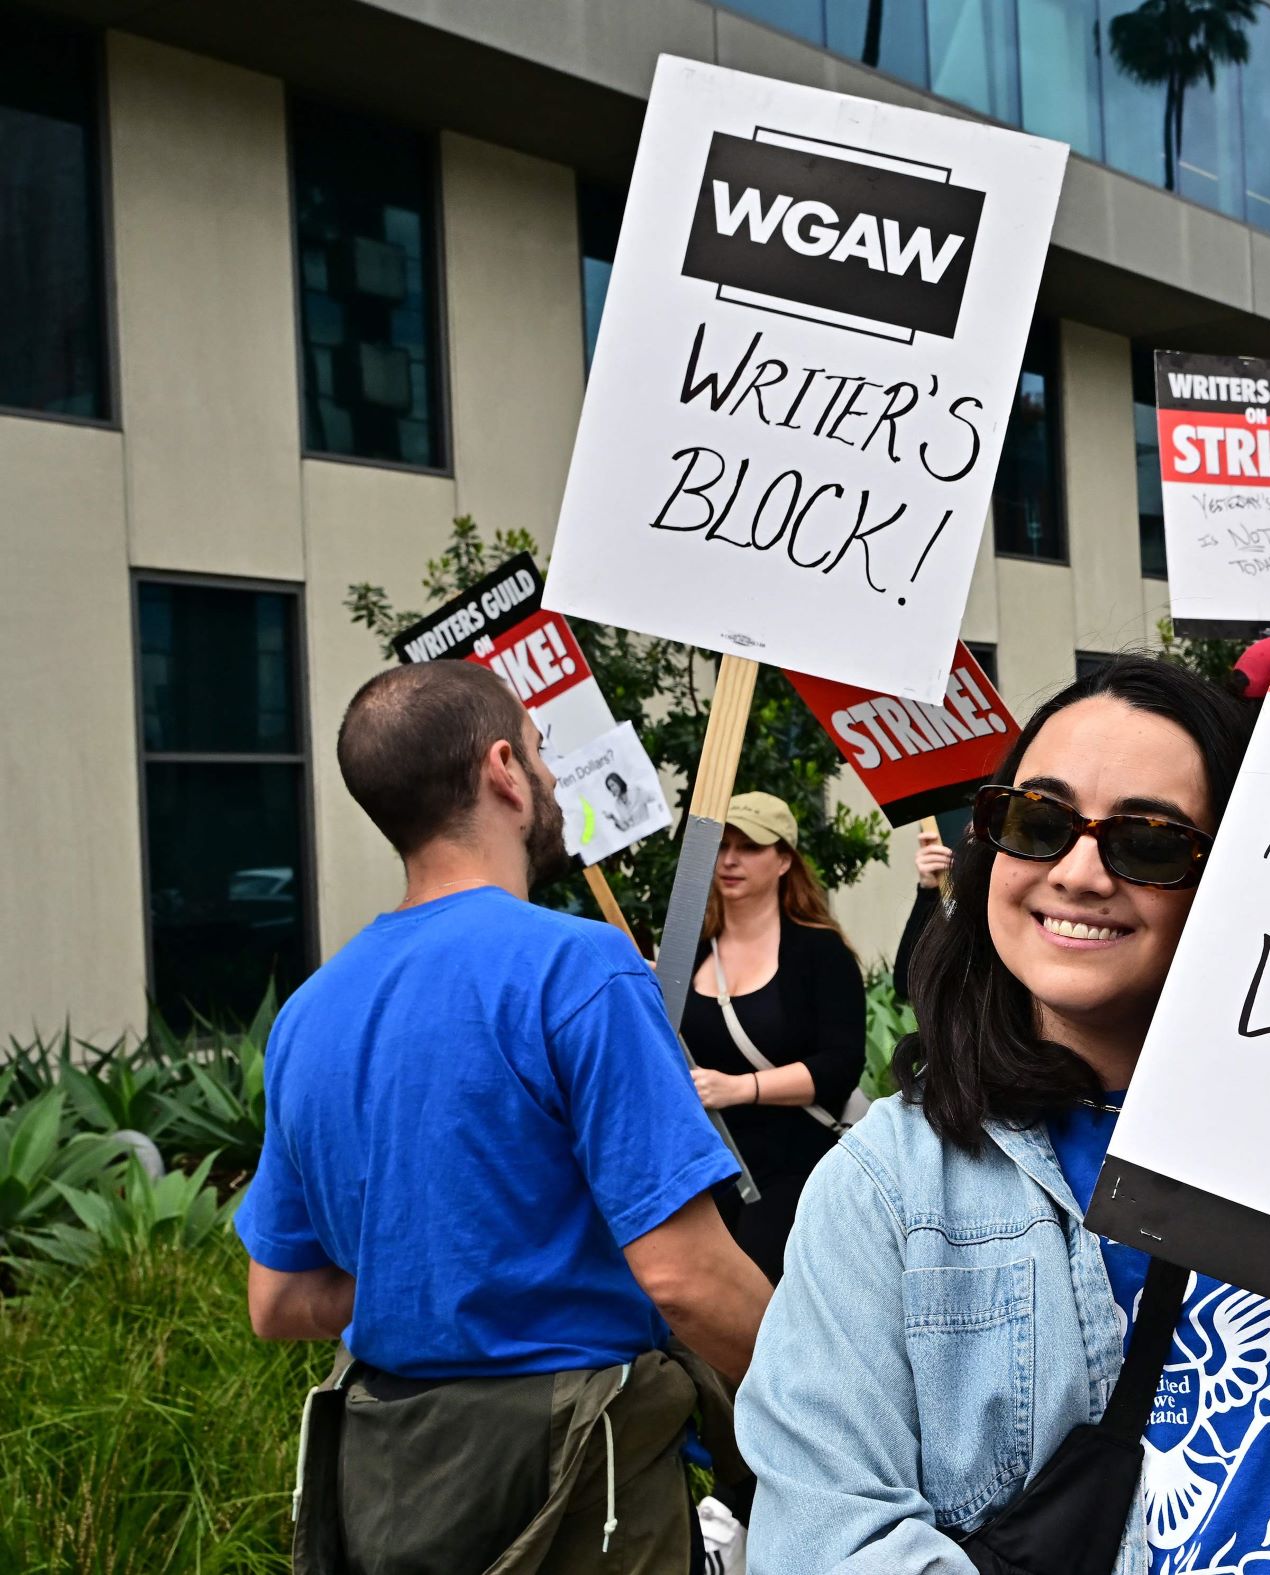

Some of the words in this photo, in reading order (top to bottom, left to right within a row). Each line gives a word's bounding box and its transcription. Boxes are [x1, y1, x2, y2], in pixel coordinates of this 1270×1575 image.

[712, 178, 965, 284] WGAW
[680, 321, 984, 482] WRITER'S
[1168, 372, 1270, 404] WRITERS
[1245, 407, 1267, 424] ON
[649, 446, 953, 607] BLOCK!
[404, 601, 486, 663] WRITERS
[481, 569, 535, 620] GUILD
[473, 634, 495, 658] ON
[489, 621, 576, 701] IKE!
[830, 666, 1008, 770] STRIKE!
[558, 775, 577, 789] Ten
[575, 749, 615, 779] Dollars?
[1153, 1394, 1176, 1408] we
[1156, 1374, 1191, 1394] ited
[1146, 1407, 1189, 1426] tand
